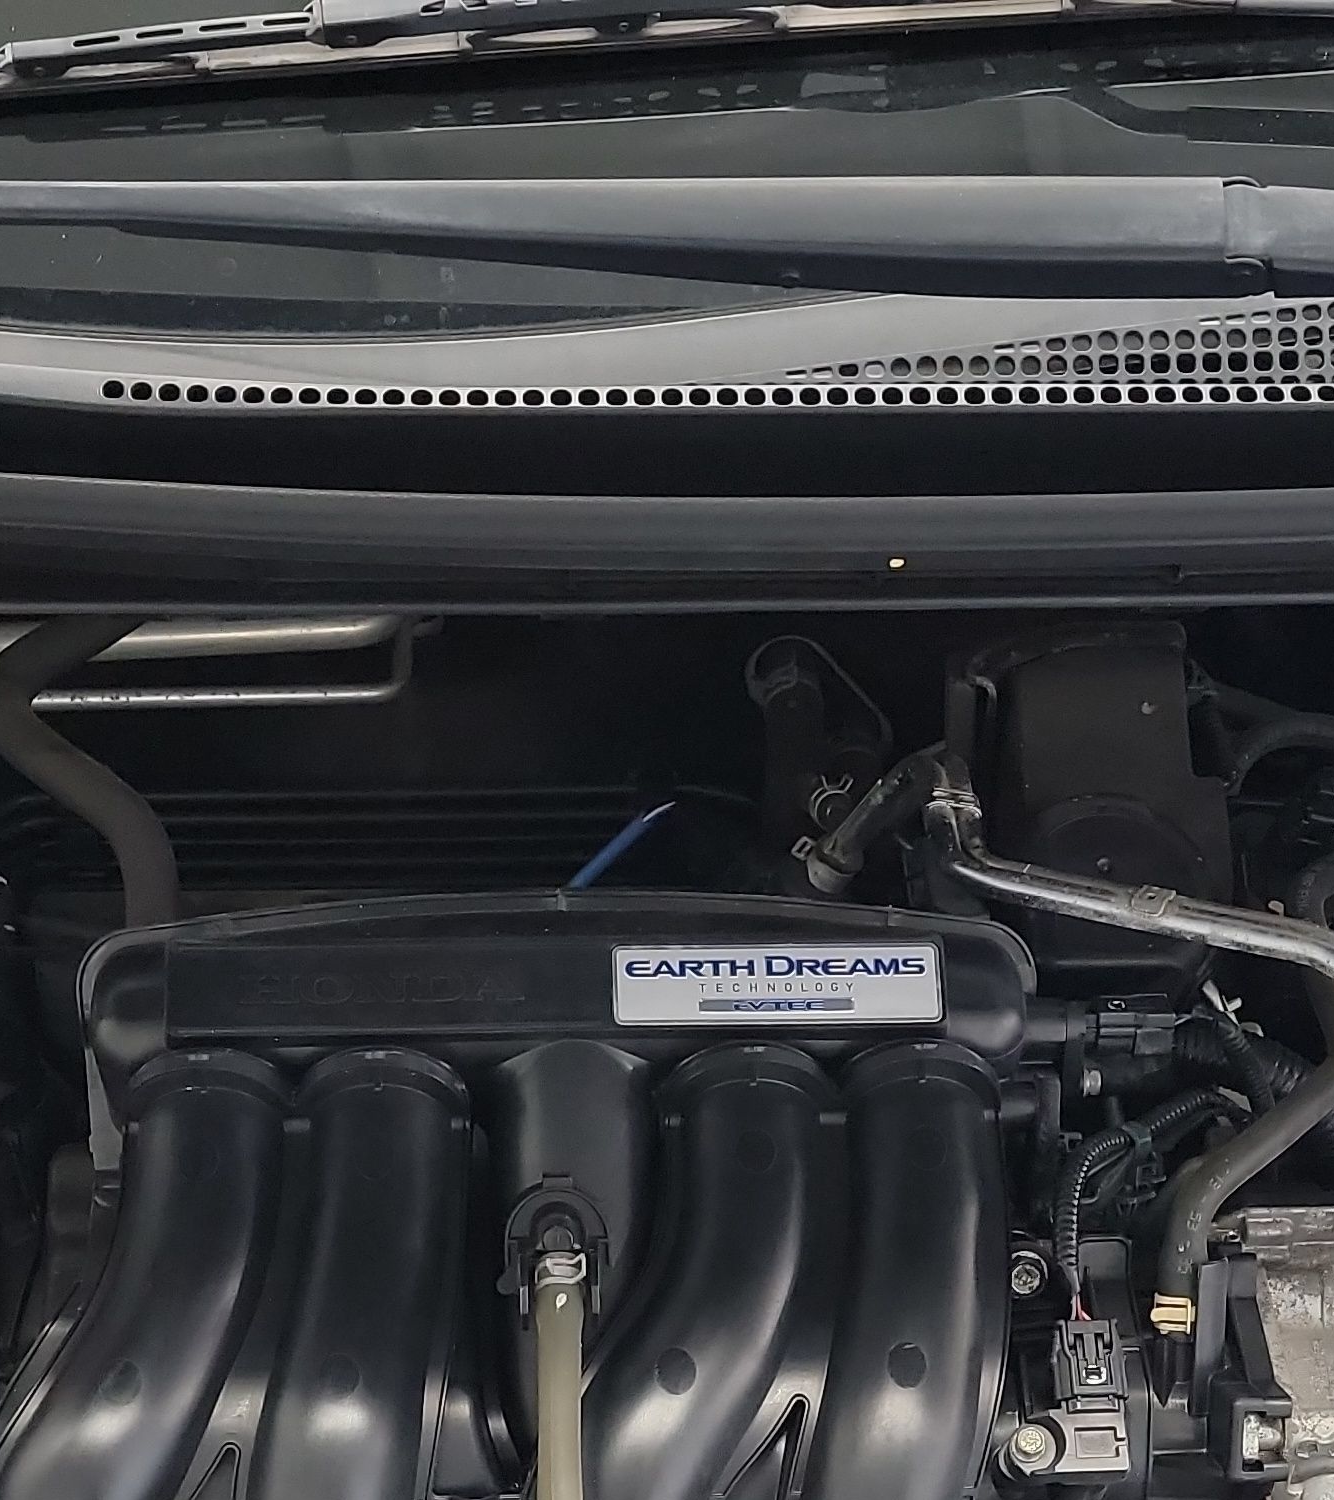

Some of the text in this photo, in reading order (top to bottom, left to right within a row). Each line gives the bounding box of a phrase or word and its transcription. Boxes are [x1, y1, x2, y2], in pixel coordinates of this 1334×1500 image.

[625, 955, 926, 978] EARTH DREAMS
[698, 982, 854, 993] TECHNOLOGY
